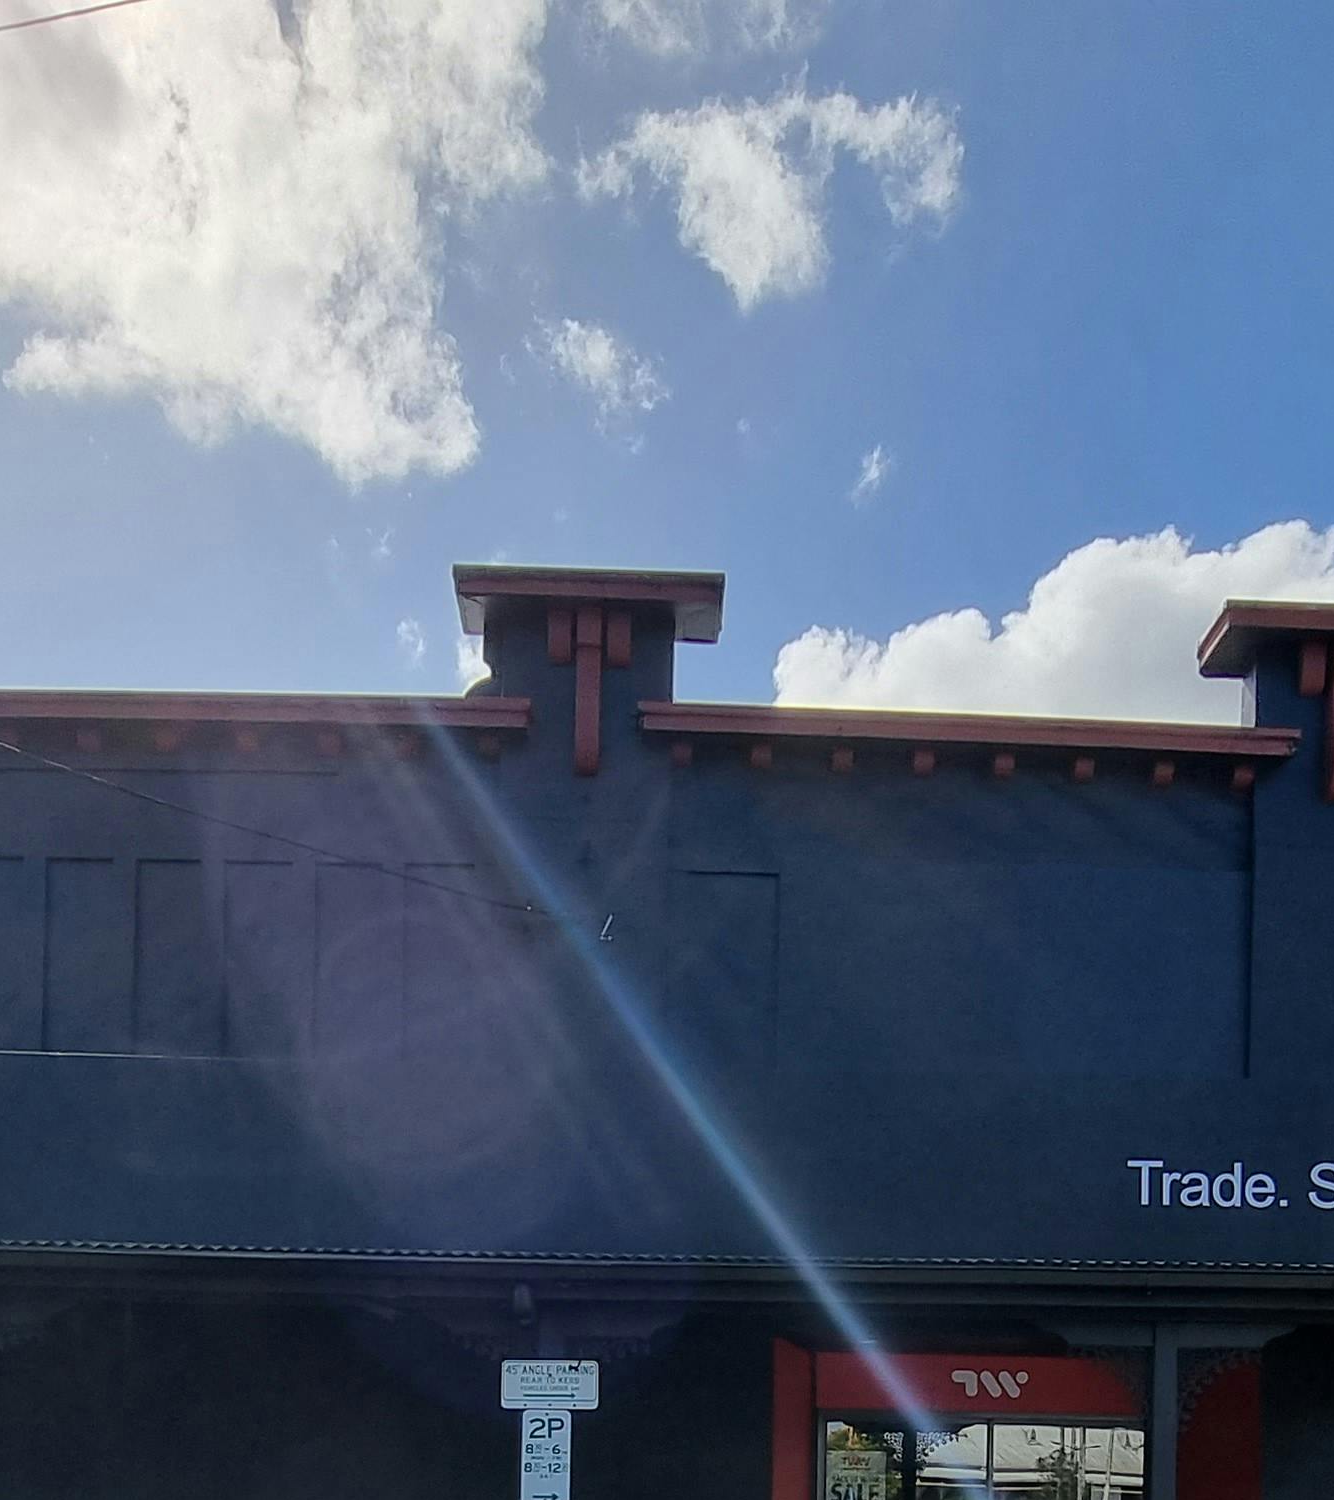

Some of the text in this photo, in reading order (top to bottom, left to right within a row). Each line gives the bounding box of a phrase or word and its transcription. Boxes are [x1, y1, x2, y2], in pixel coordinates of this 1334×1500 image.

[1126, 1159, 1290, 1207] Trade.
[522, 1364, 553, 1375] ANGLE
[529, 1417, 565, 1439] 2P
